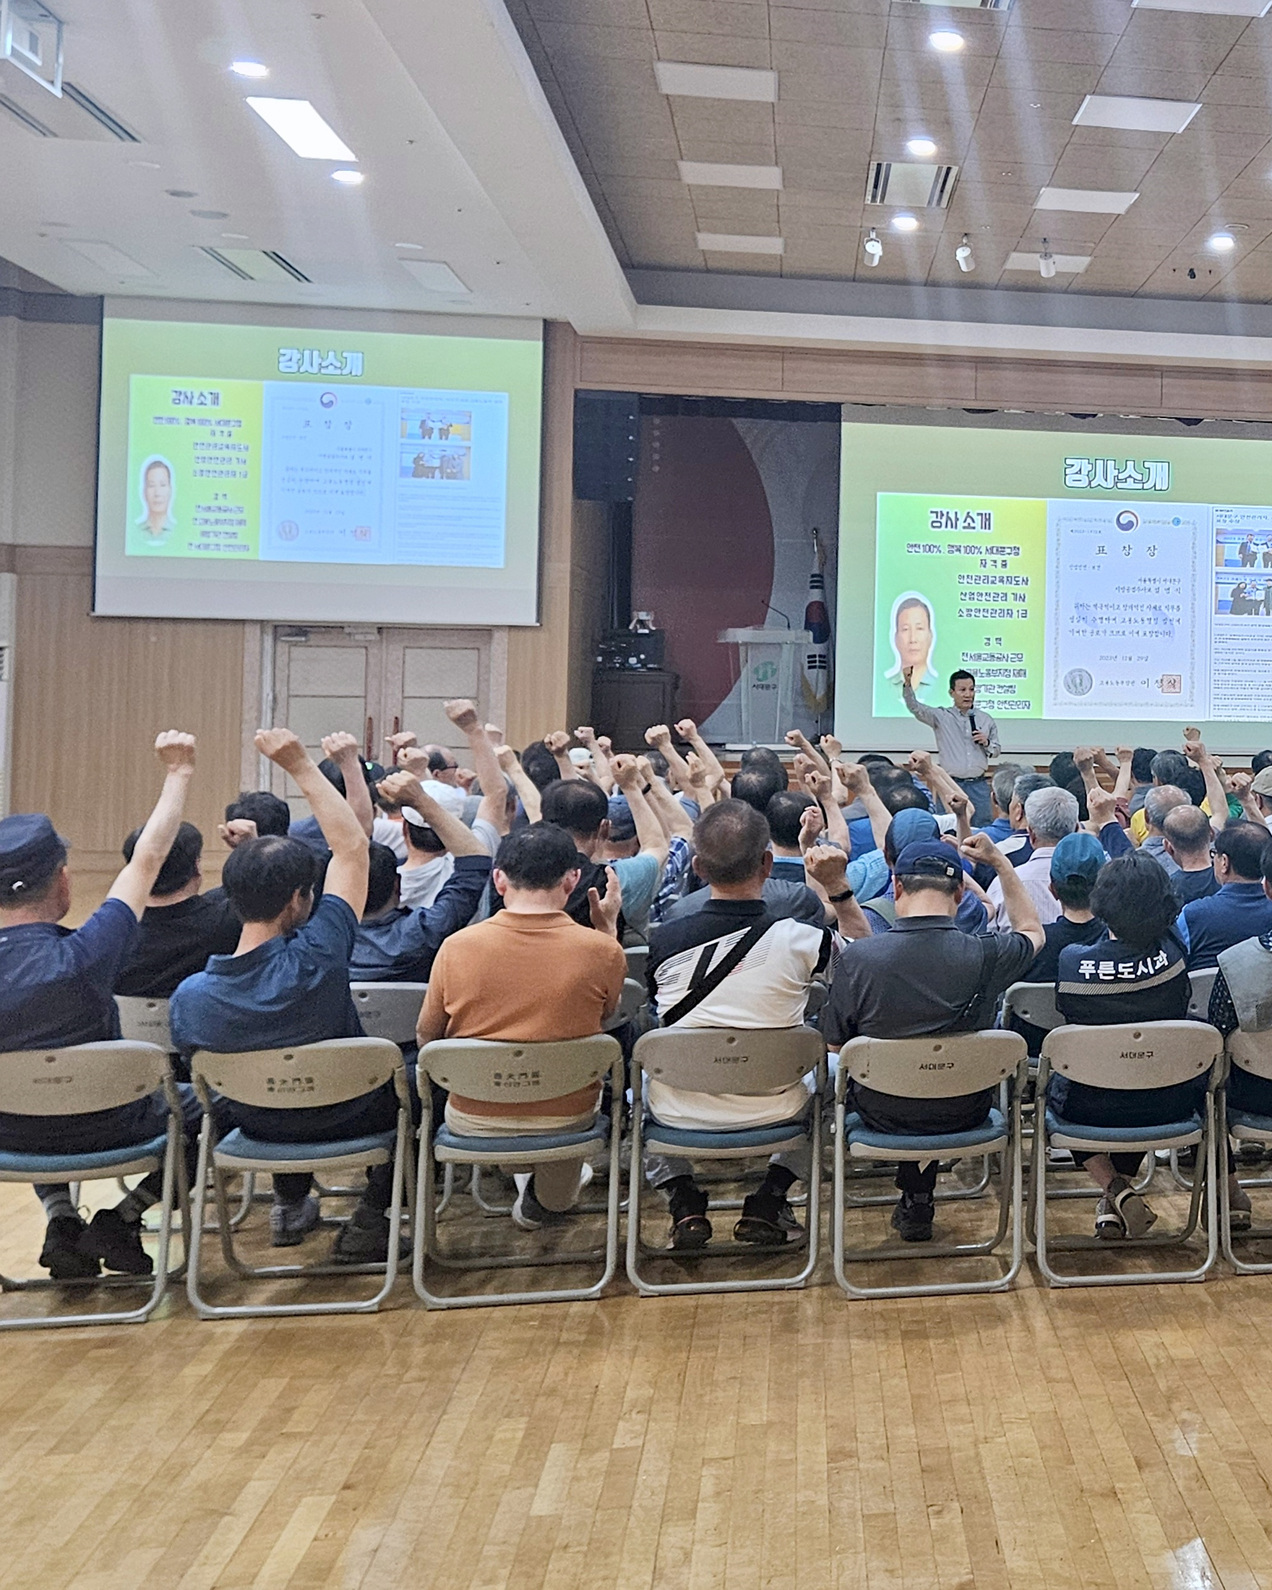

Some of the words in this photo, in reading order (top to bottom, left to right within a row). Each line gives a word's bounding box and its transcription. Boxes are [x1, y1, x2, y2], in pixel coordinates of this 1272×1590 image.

[277, 347, 364, 377] 강사소개
[1063, 457, 1171, 492] 강사소개
[929, 509, 960, 531] 강사
[961, 511, 993, 531] 소개
[957, 574, 1030, 587] 안전관리교육지도사
[1010, 592, 1027, 603] 기사
[957, 607, 1014, 619] 소방안전관리자
[1078, 949, 1170, 980] 푸른도시과
[1119, 1051, 1154, 1059] 서대문구
[919, 1062, 955, 1071] 서대문구
